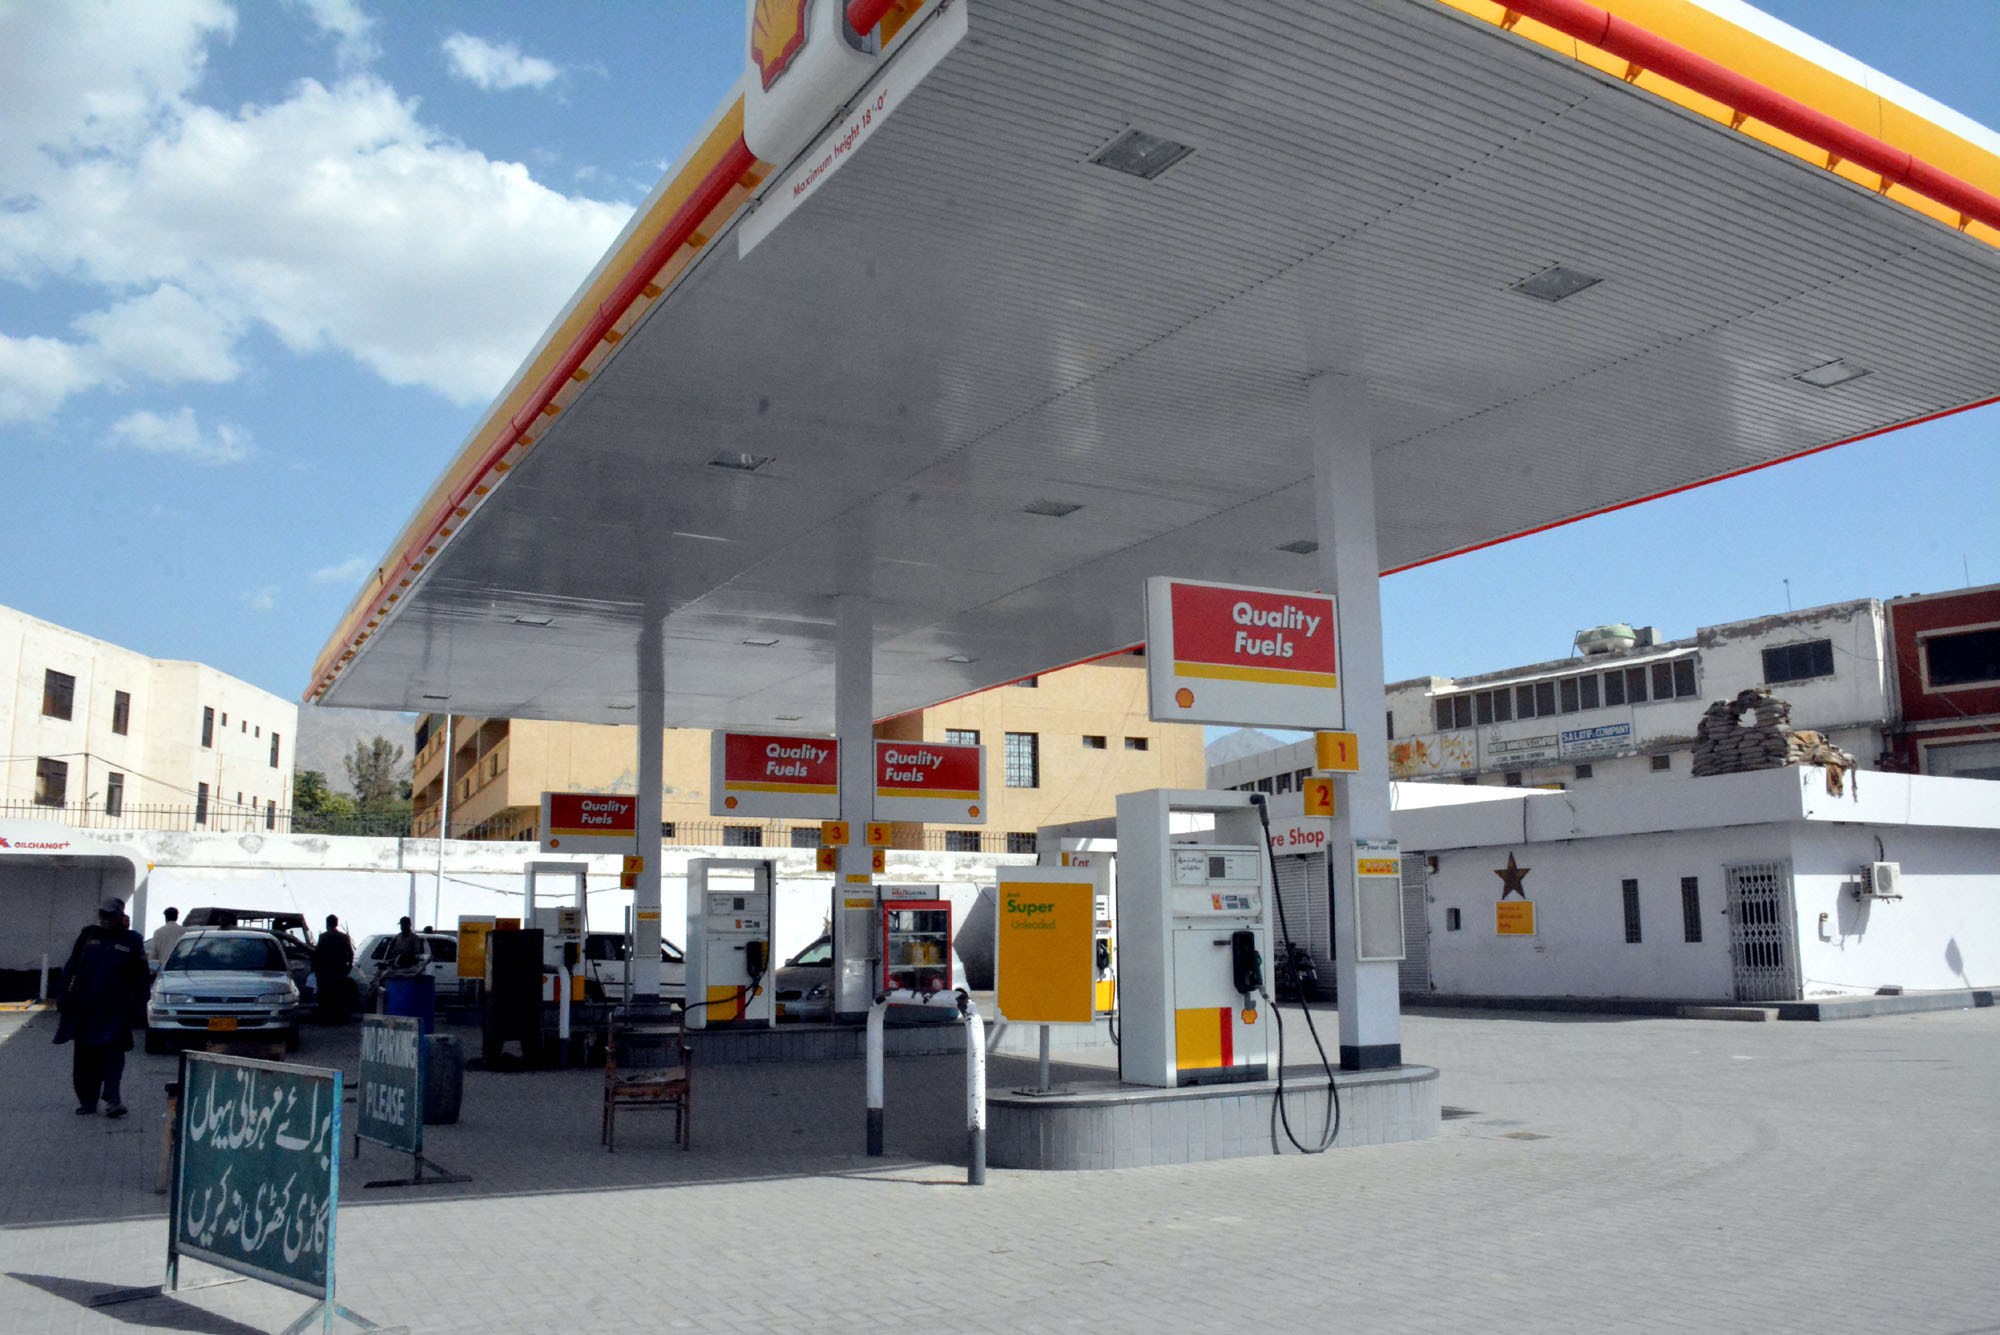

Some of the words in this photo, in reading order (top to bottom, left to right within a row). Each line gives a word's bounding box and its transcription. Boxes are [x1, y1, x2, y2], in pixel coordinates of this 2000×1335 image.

[794, 155, 832, 199] Maximum
[834, 124, 860, 158] height
[1232, 602, 1321, 638] Quality
[1234, 631, 1294, 658] Fuels
[1596, 724, 1629, 737] COMPANY
[766, 743, 829, 764] Quality
[884, 750, 943, 769] Quality
[1338, 741, 1346, 762] 1
[766, 760, 808, 777] Fuels
[885, 767, 924, 782] Fuels
[1316, 785, 1330, 806] 2
[581, 800, 629, 815] Quality
[581, 813, 613, 824] Fuels
[831, 826, 842, 840] 3
[873, 828, 882, 841] 5
[1289, 827, 1325, 847] Shop
[629, 860, 637, 869] 7
[823, 853, 832, 867] 4
[873, 854, 882, 868] 6
[1007, 899, 1054, 916] Super
[1011, 919, 1056, 929] Unleaded
[363, 1026, 376, 1062] NO
[377, 1027, 417, 1069] PARKING
[367, 1081, 404, 1126] PLEASE
[188, 1163, 234, 1248] کریں
[223, 1190, 243, 1237] نہ
[241, 1172, 297, 1252] کھڑی
[283, 1192, 329, 1264] گاڑی
